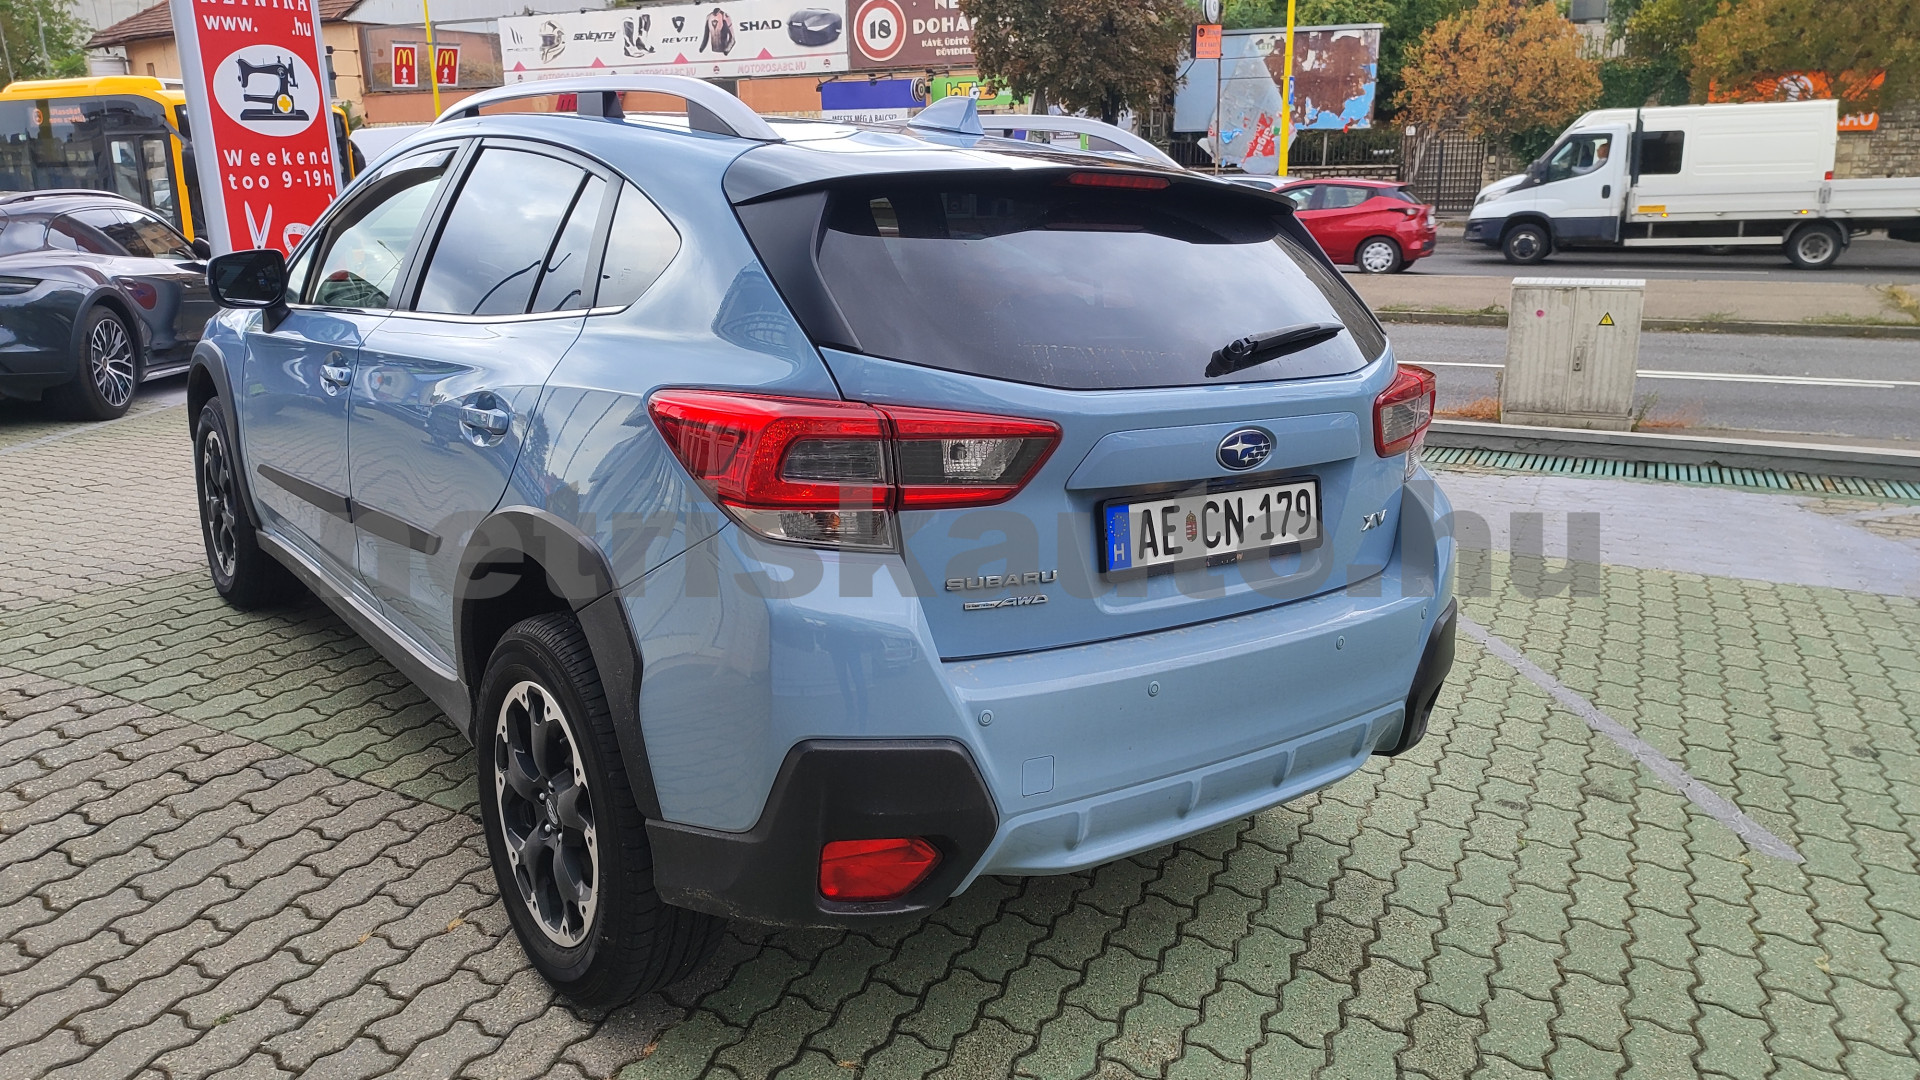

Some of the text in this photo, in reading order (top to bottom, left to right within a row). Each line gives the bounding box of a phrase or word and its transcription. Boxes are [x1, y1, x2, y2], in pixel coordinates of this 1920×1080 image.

[203, 15, 312, 36] www. .hu
[739, 19, 782, 31] SHAD
[869, 19, 892, 40] 18
[573, 31, 616, 42] SEVENTY
[223, 147, 330, 166] Weekend
[228, 169, 332, 190] too 9-19h
[1360, 509, 1388, 532] XV
[1138, 505, 1184, 560] AE
[1113, 543, 1126, 562] H
[945, 569, 1058, 592] SUBARU
[996, 594, 1049, 608] AWD
